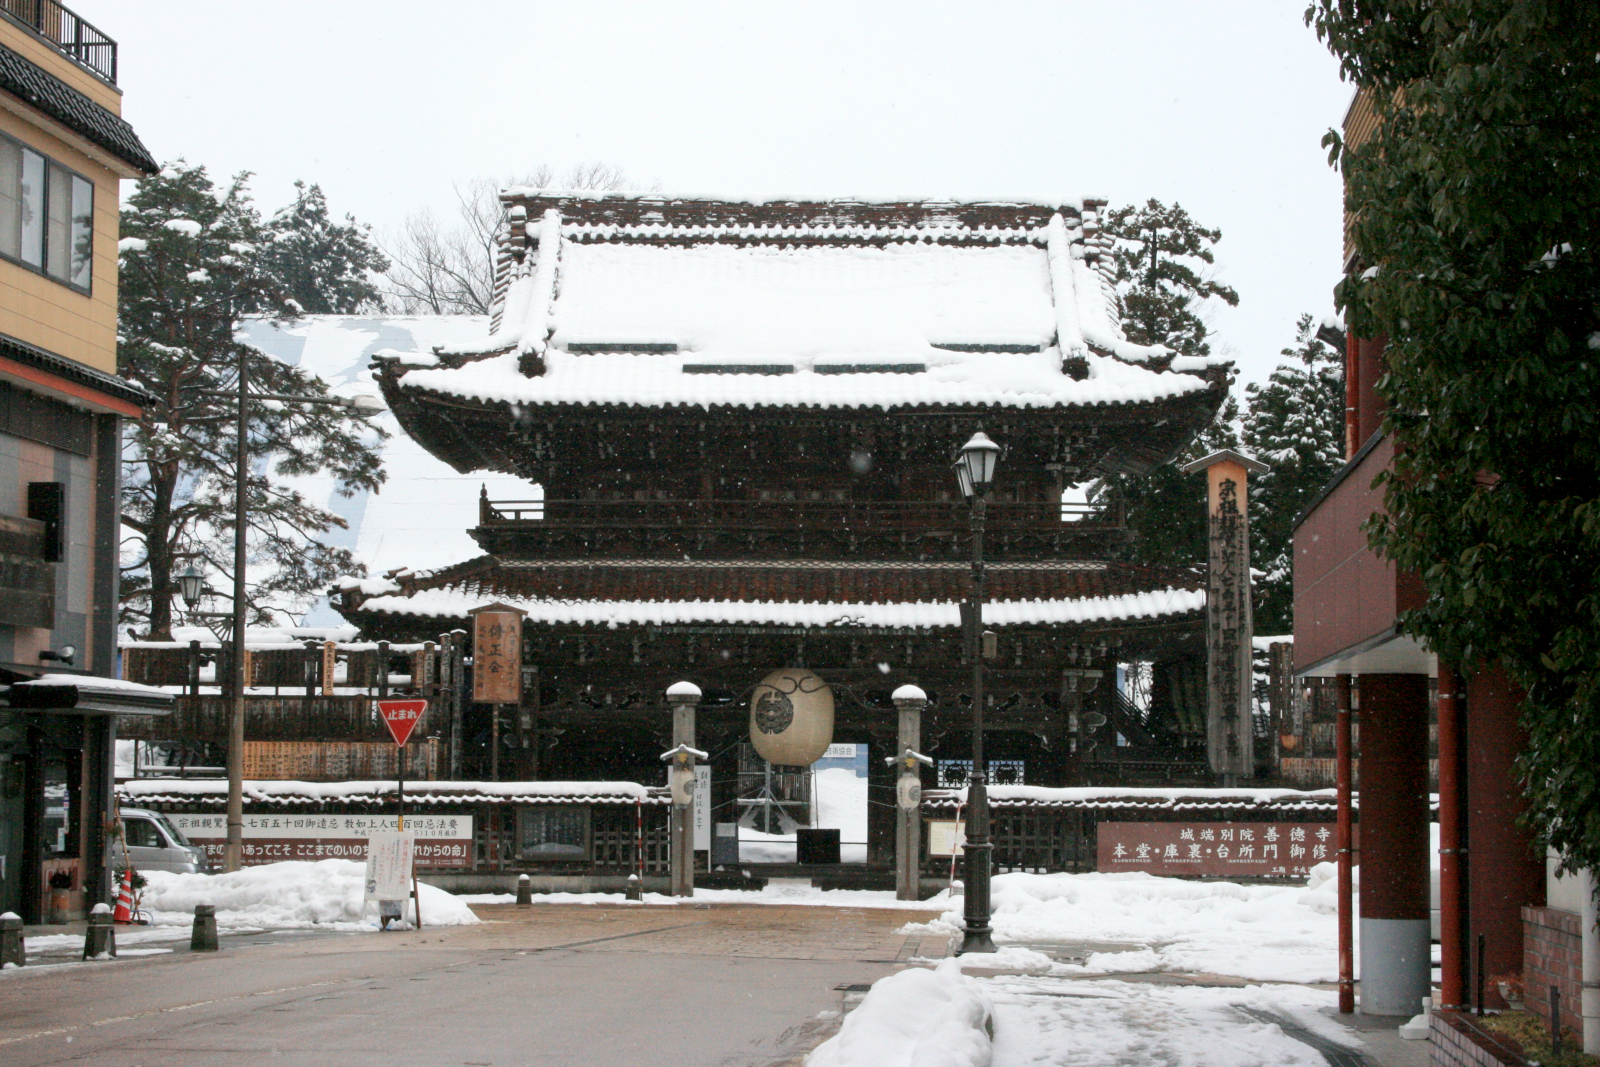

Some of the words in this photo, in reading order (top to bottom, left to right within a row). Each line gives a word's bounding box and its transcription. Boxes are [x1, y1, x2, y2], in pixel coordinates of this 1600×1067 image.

[488, 623, 505, 673] 修正会
[387, 709, 417, 720] 止まれ
[179, 817, 339, 830] 宗祖親鸞七百五十回御遠忌
[343, 818, 459, 830] 教如上人四百回忌法要
[1113, 843, 1338, 860] 本堂・庫裏・台所門御修
